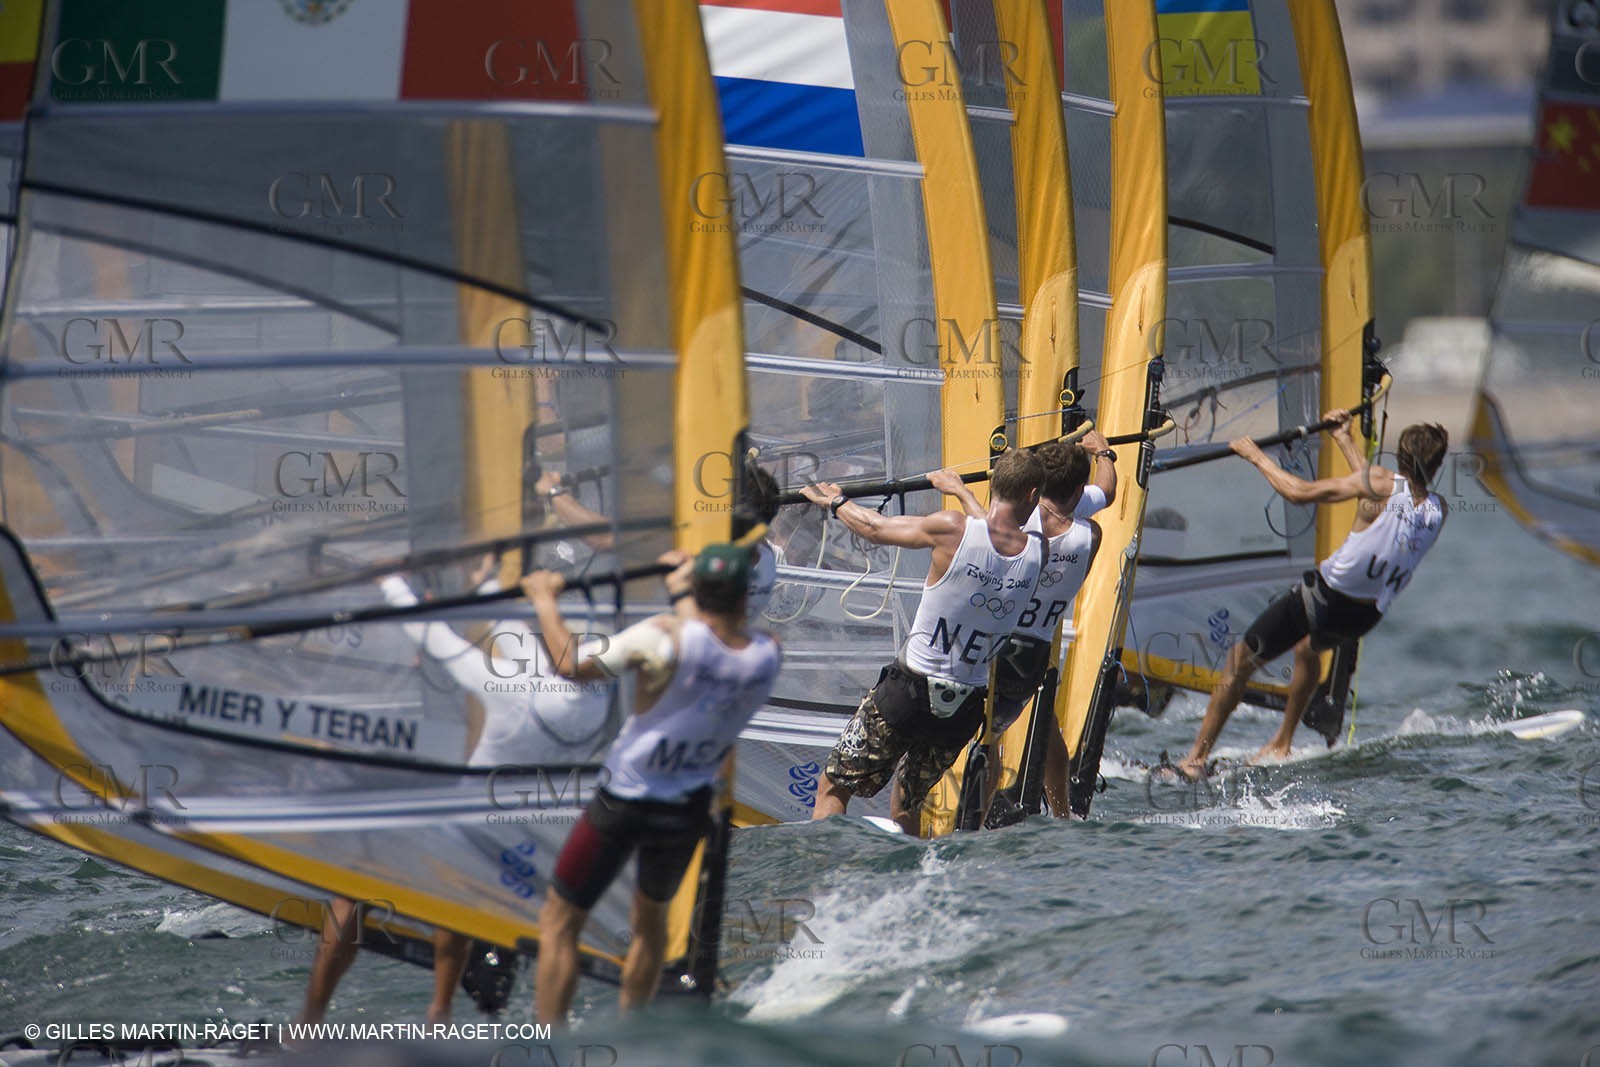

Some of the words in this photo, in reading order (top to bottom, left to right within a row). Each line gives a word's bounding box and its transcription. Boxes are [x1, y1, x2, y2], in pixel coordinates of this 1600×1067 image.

[1051, 552, 1079, 564] 2008
[966, 562, 1003, 592] Beijing
[1006, 577, 1032, 590] 2008
[178, 683, 263, 726] MIER
[276, 700, 298, 731] Y
[308, 704, 417, 751] TERAN
